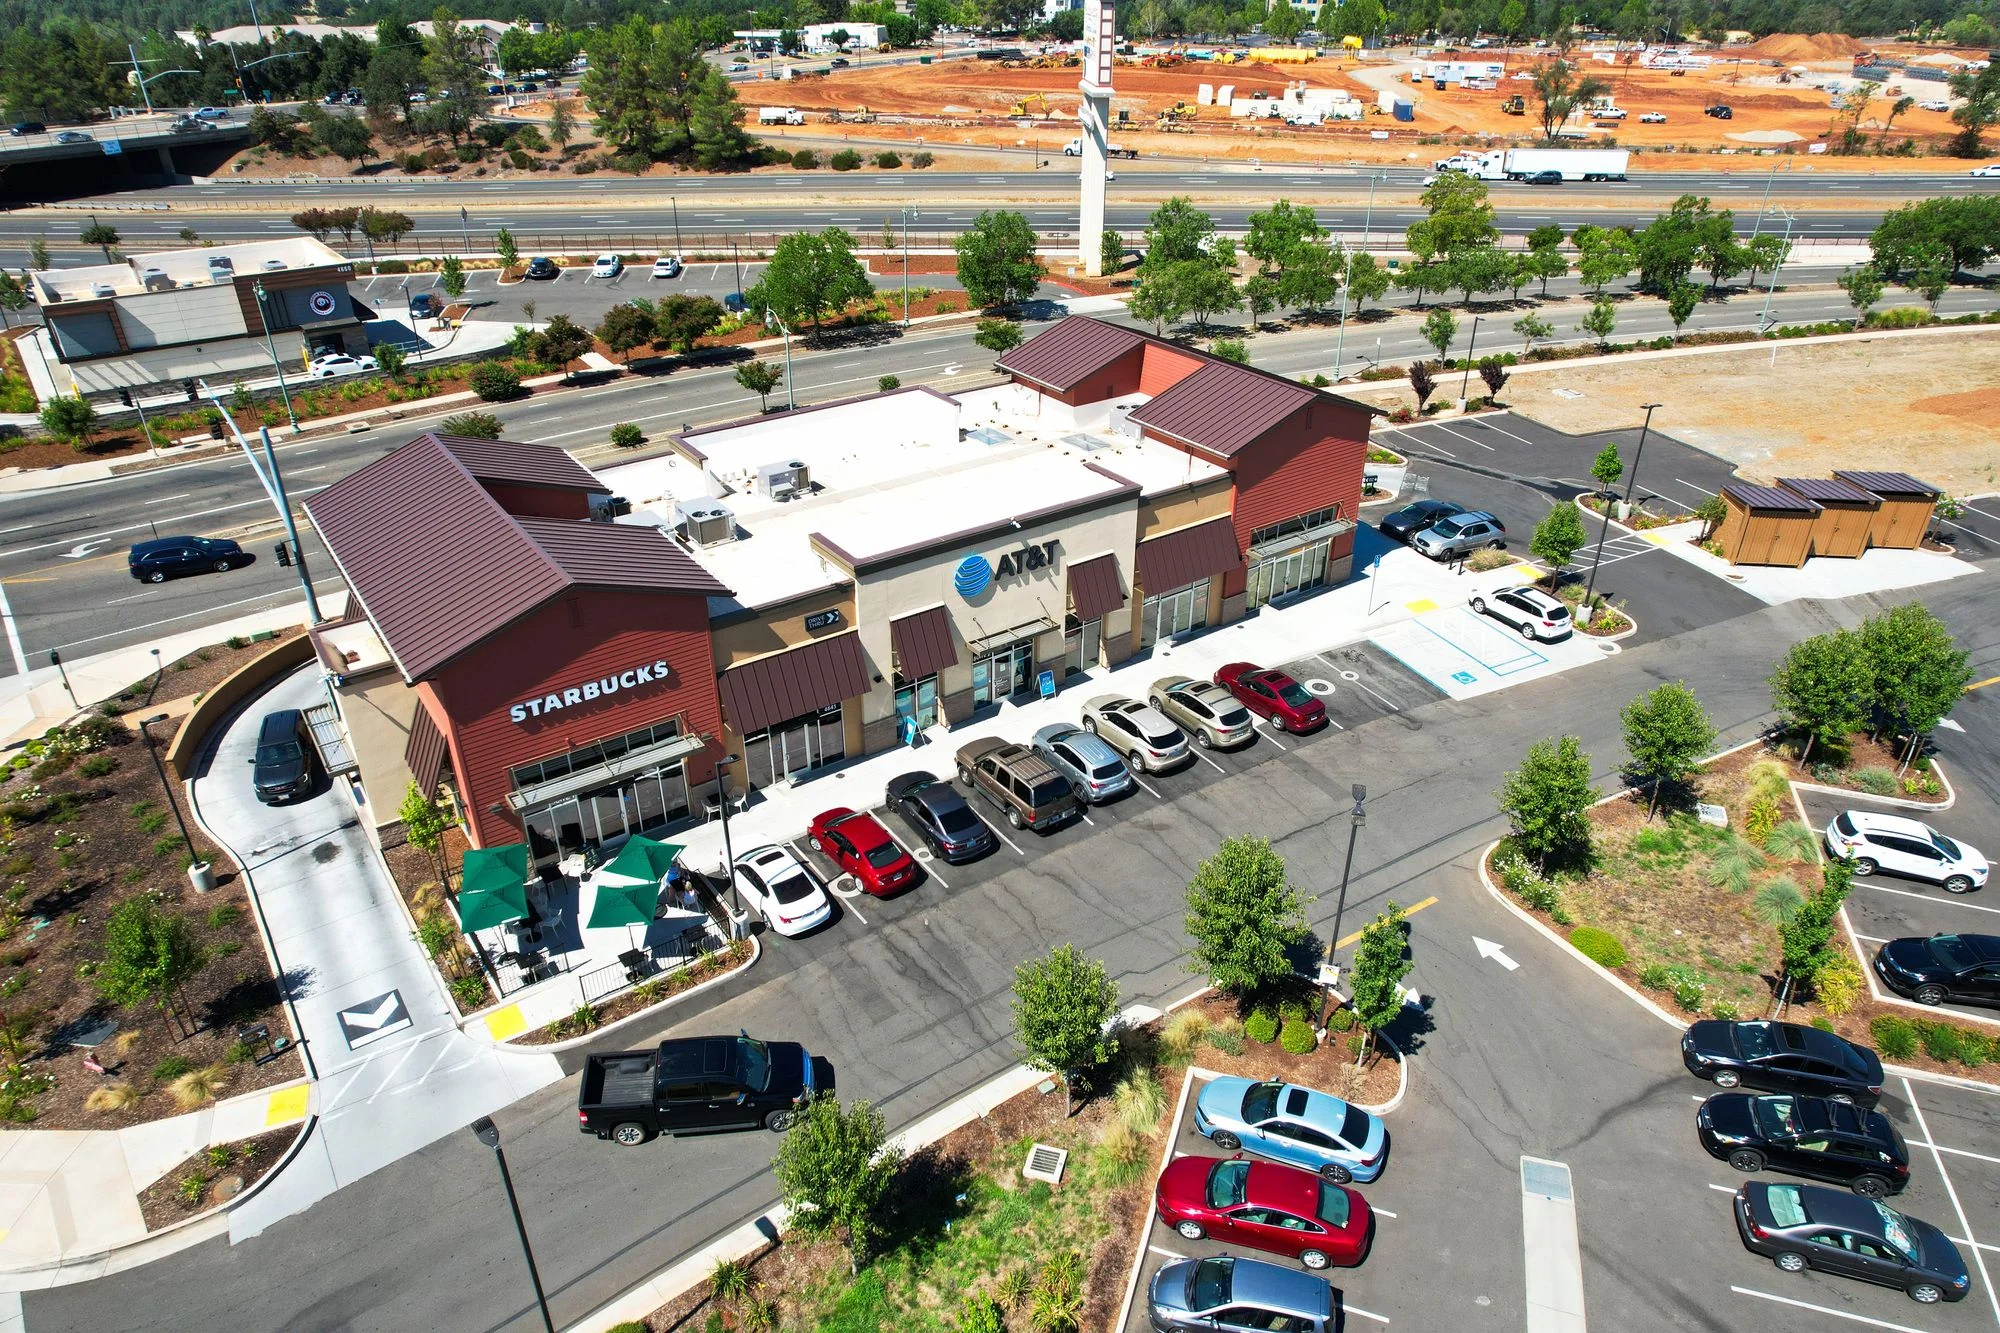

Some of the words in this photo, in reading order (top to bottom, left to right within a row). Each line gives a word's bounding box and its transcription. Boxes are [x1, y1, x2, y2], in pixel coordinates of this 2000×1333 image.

[994, 539, 1060, 580] AT&T
[808, 615, 825, 624] DRIVE
[809, 620, 825, 629] THRU
[509, 660, 669, 723] STARBUCKS
